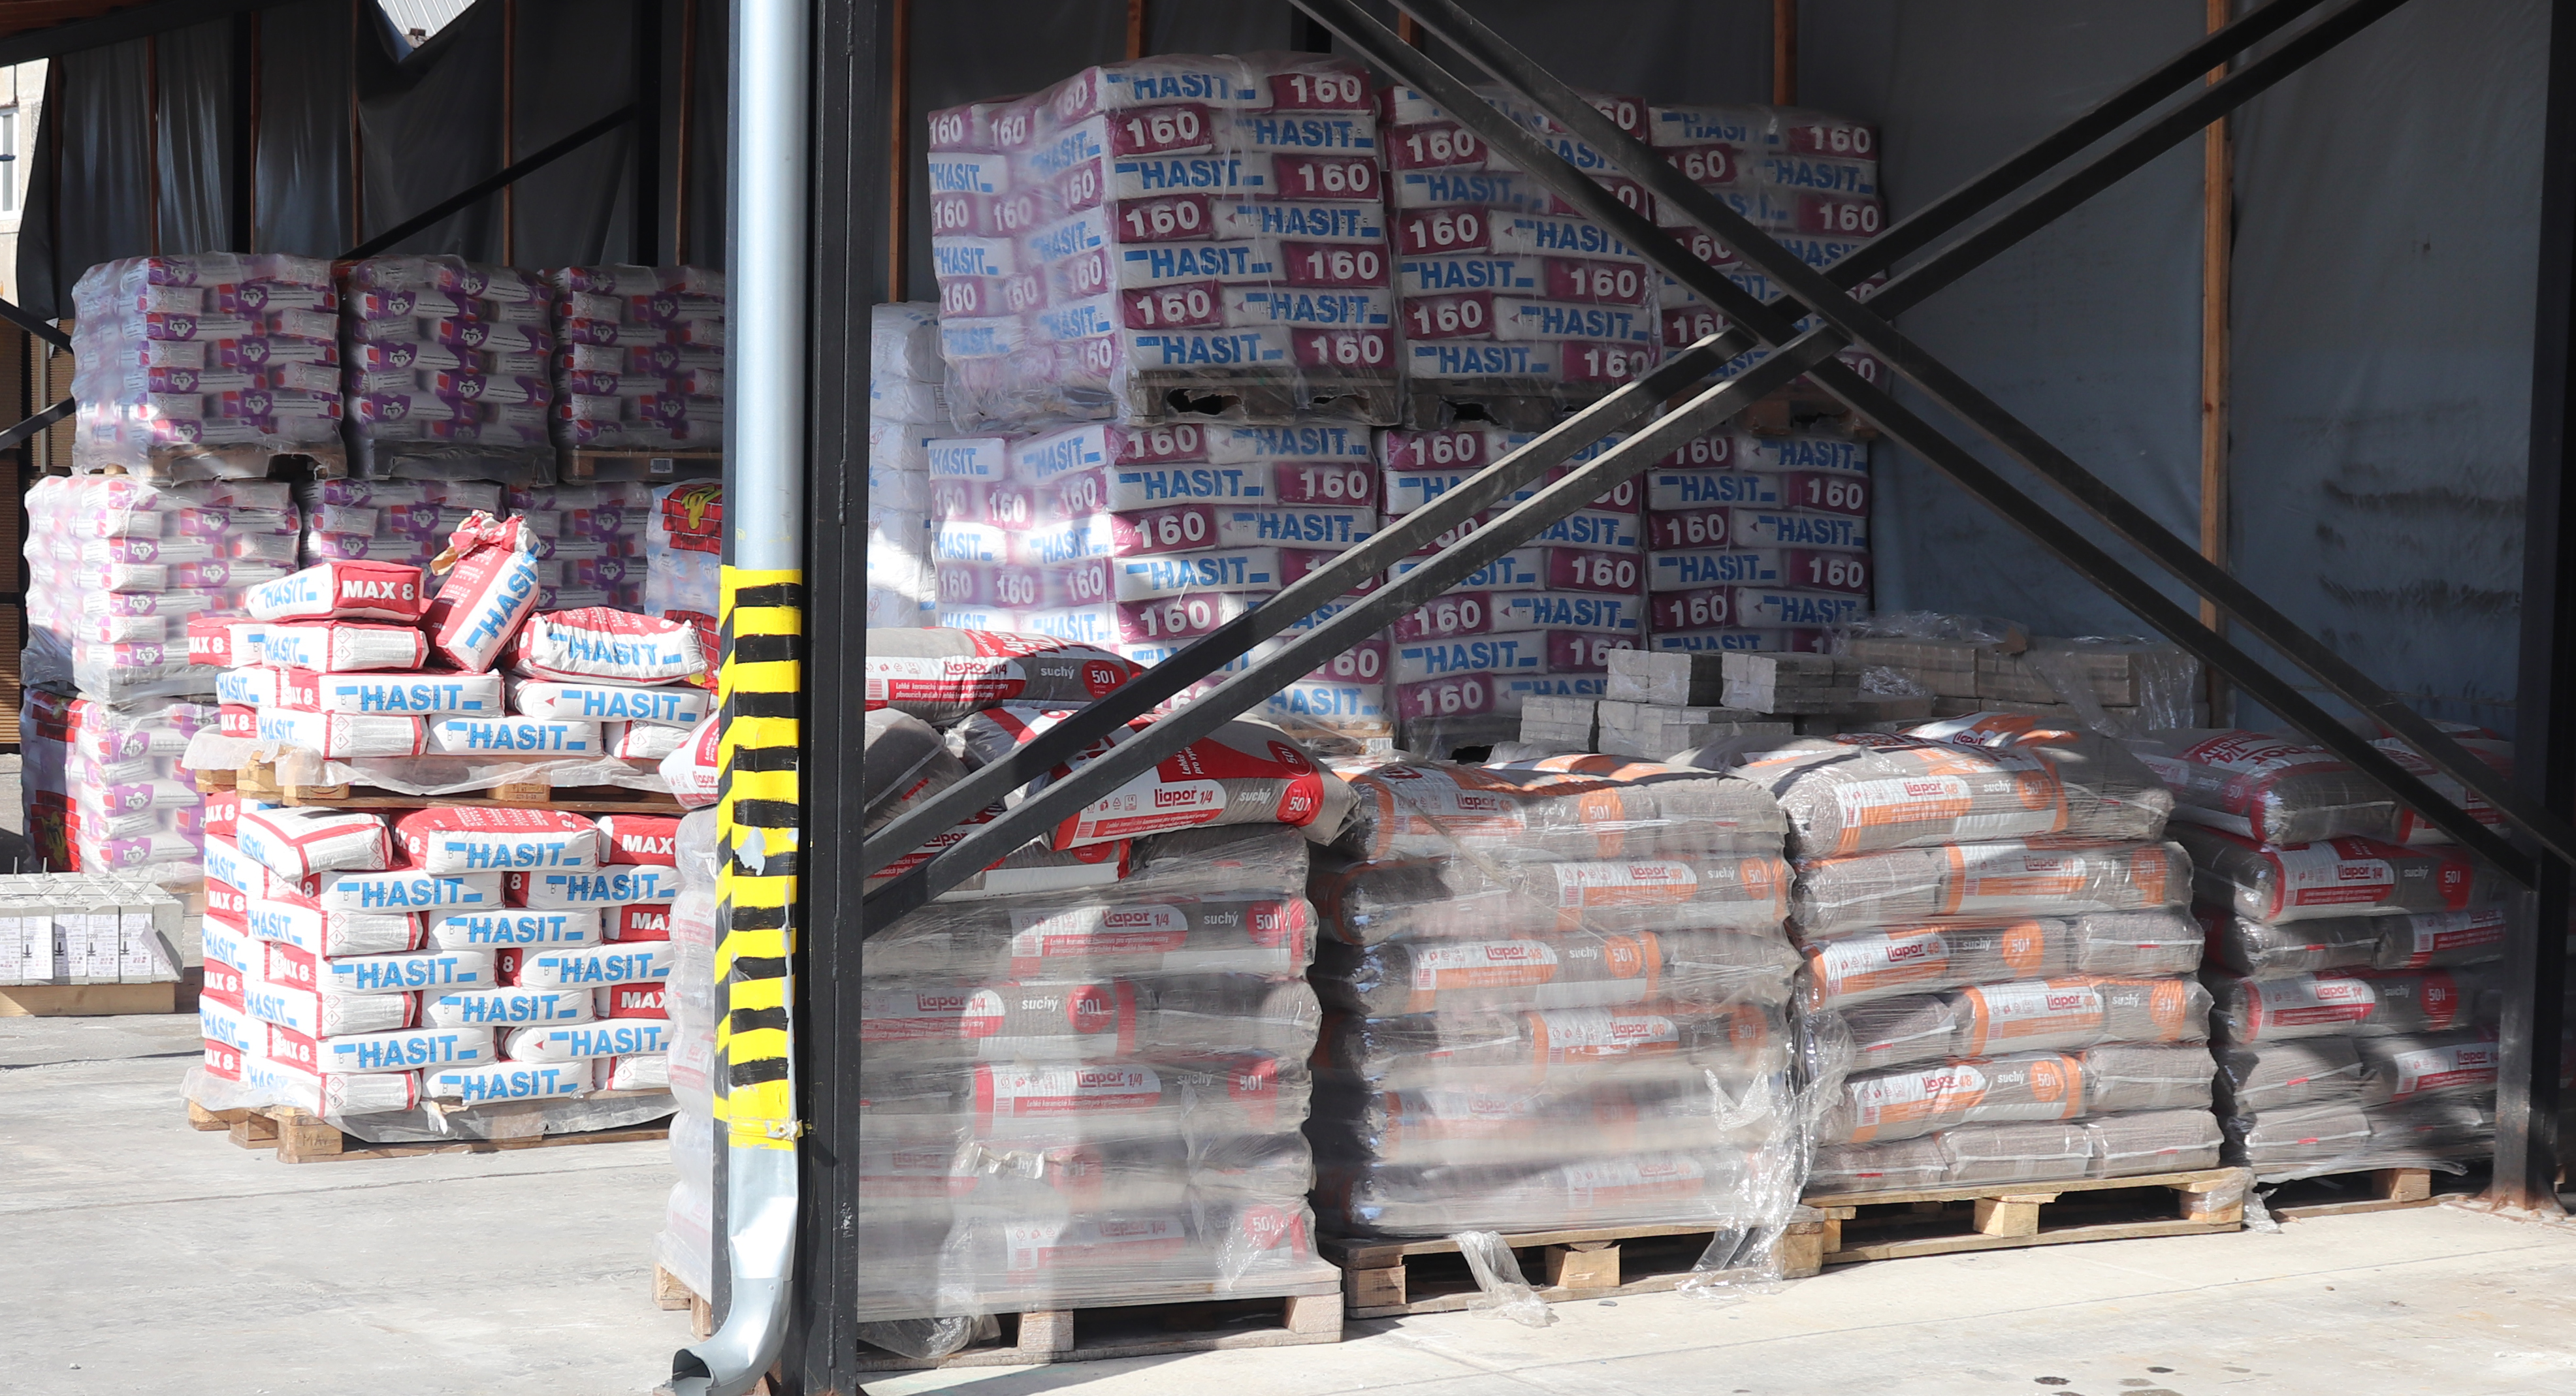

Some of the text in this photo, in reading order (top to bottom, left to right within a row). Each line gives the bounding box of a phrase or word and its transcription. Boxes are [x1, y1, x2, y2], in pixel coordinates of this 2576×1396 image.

[1133, 72, 1229, 100] HASIT
[1290, 74, 1362, 103] 160
[929, 114, 963, 145] 160
[990, 116, 1026, 146] 160
[1127, 111, 1200, 148] 160
[1257, 119, 1354, 148] HASIT
[1809, 126, 1871, 154] 160
[1406, 129, 1475, 162] 160
[936, 163, 980, 191] HASIT
[1140, 159, 1241, 189] HASIT
[1298, 163, 1370, 193] 160
[1428, 174, 1513, 202] HASIT
[1774, 159, 1861, 193] HASIT
[934, 199, 969, 229] 160
[1126, 200, 1200, 237] 160
[1261, 206, 1362, 238] HASIT
[1819, 204, 1879, 232] 160
[1410, 213, 1479, 248] 160
[941, 247, 985, 276] HASIT
[1151, 247, 1250, 279] HASIT
[1307, 251, 1379, 280] 160
[1420, 261, 1515, 289] HASIT
[944, 281, 976, 311] 160
[1570, 267, 1637, 298] 160
[1136, 289, 1211, 325] 160
[1270, 293, 1369, 324] HASIT
[1414, 300, 1483, 335] 160
[1542, 306, 1633, 340] HASIT
[1161, 334, 1261, 365] HASIT
[1311, 336, 1384, 365] 160
[1440, 347, 1530, 374] HASIT
[1128, 424, 1198, 458] 160
[1255, 428, 1347, 456] HASIT
[1409, 433, 1476, 466] 160
[1778, 441, 1855, 469] HASIT
[932, 449, 976, 475] HASIT
[1036, 437, 1084, 477] HASIT
[1143, 469, 1244, 500] HASIT
[1300, 469, 1368, 500] 160
[1681, 475, 1760, 502] HASIT
[1807, 477, 1864, 510] 160
[990, 490, 1027, 523] 160
[1135, 511, 1206, 548] 160
[1257, 513, 1355, 543] HASIT
[1667, 514, 1726, 545] 160
[1777, 516, 1853, 546] HASIT
[939, 532, 982, 561] HASIT
[1043, 528, 1091, 563] HASIT
[941, 569, 973, 598] 160
[1067, 565, 1103, 601] 160
[1150, 556, 1248, 591] HASIT
[1571, 556, 1637, 588] 160
[1680, 554, 1760, 583] HASIT
[1809, 557, 1865, 588] 160
[265, 577, 308, 609] HASIT
[342, 580, 415, 601] MAX 8
[1140, 599, 1212, 637] 160
[1414, 599, 1481, 635] 160
[1533, 597, 1622, 628] HASIT
[1669, 595, 1728, 627] 160
[1780, 595, 1858, 624] HASIT
[212, 636, 225, 653] 8
[265, 635, 300, 663] HASIT
[568, 636, 658, 666] HASIT
[1426, 641, 1519, 674] HASIT
[1040, 665, 1075, 680] suchý
[304, 687, 314, 705] 8
[360, 684, 463, 711] HASIT
[583, 690, 682, 722] HASIT
[1417, 681, 1484, 717] 160
[239, 714, 250, 731] 8
[467, 723, 568, 750] HASIT
[1200, 790, 1214, 805] 1/4
[1239, 787, 1271, 804] suchý
[225, 803, 235, 819] 8
[409, 836, 421, 854] 8
[467, 842, 566, 868] HASIT
[621, 834, 674, 855] MAX
[207, 852, 236, 887] HASIT
[511, 874, 522, 891] 8
[208, 889, 245, 912] MAX 8
[304, 881, 314, 898] 8
[362, 878, 464, 908] HASIT
[566, 873, 660, 902] HASIT
[250, 912, 292, 939] HASIT
[468, 916, 566, 943] HASIT
[1154, 913, 1170, 927] 1/4
[1204, 911, 1239, 928] suchý
[205, 930, 237, 966] HASIT
[298, 964, 310, 982] 8
[357, 956, 458, 990] HASIT
[503, 955, 515, 973] 8
[560, 953, 654, 983] HASIT
[226, 975, 238, 992] 8
[246, 992, 285, 1023] HASIT
[462, 994, 560, 1023] HASIT
[970, 996, 986, 1011] 1/4
[203, 1012, 236, 1051] HASIT
[572, 1026, 662, 1057] HASIT
[223, 1053, 234, 1071] 8
[298, 1044, 310, 1062] 8
[359, 1034, 458, 1069] HASIT
[464, 1069, 560, 1102] HASIT
[1959, 1075, 1973, 1088] 4/8
